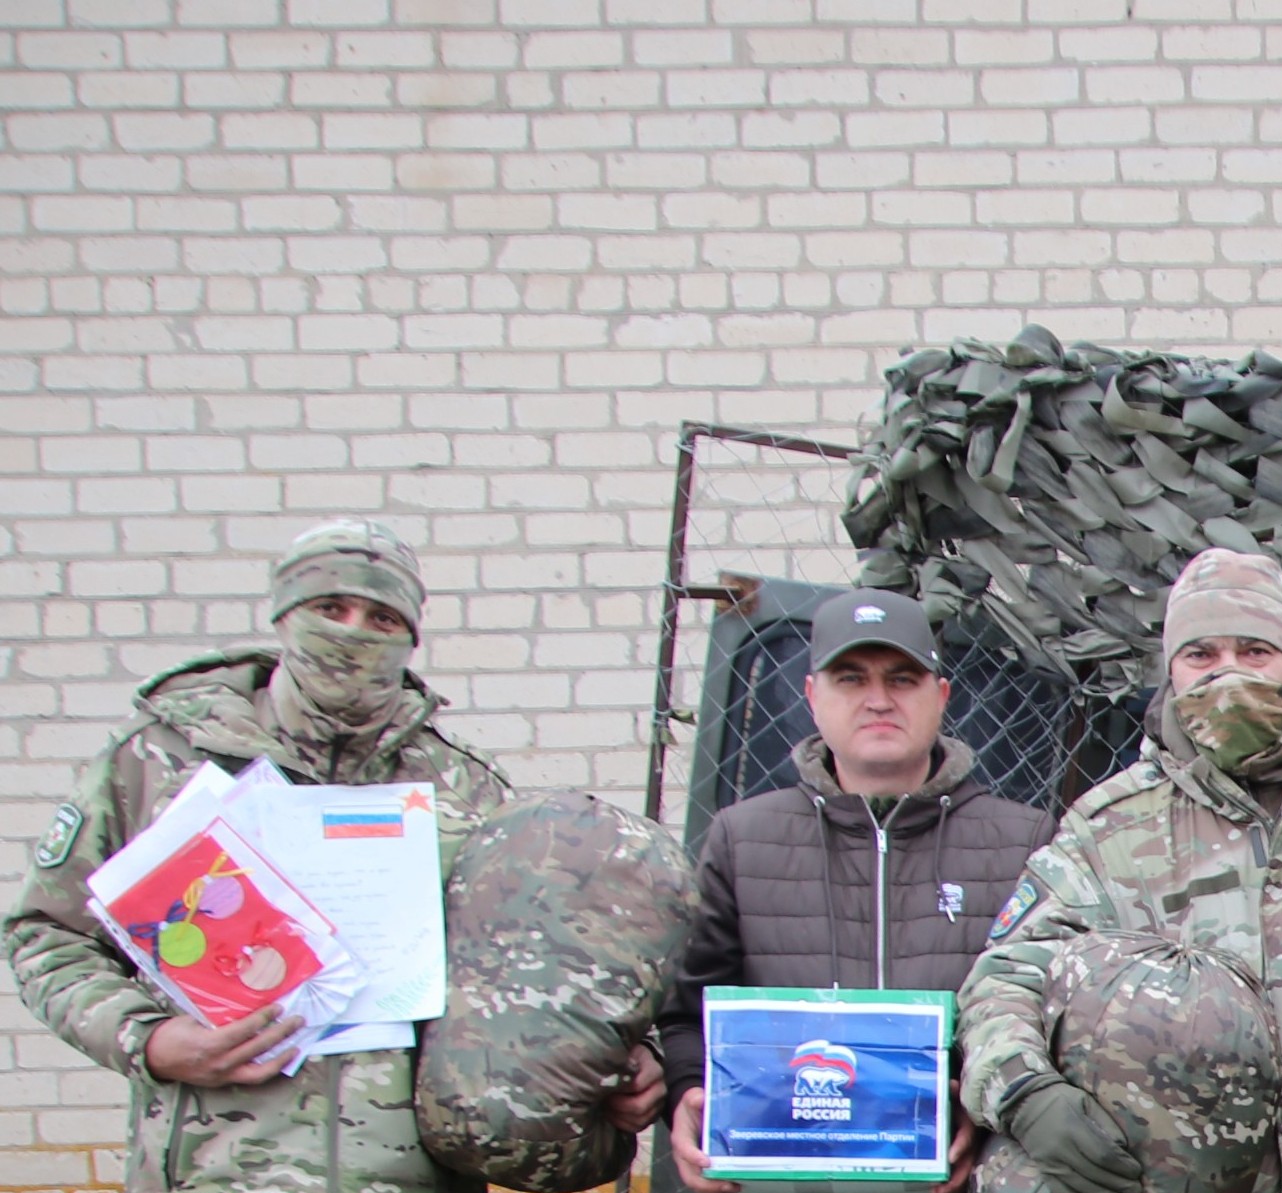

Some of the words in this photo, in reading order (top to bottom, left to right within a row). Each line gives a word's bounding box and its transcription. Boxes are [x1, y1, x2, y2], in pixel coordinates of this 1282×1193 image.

[792, 1097, 851, 1109] ЕДИНАЯ
[792, 1108, 851, 1120] РОССИЯ
[729, 1129, 785, 1141] Зверевское
[786, 1132, 827, 1141] местное
[828, 1132, 878, 1142] отделение
[879, 1131, 915, 1143] Партии
